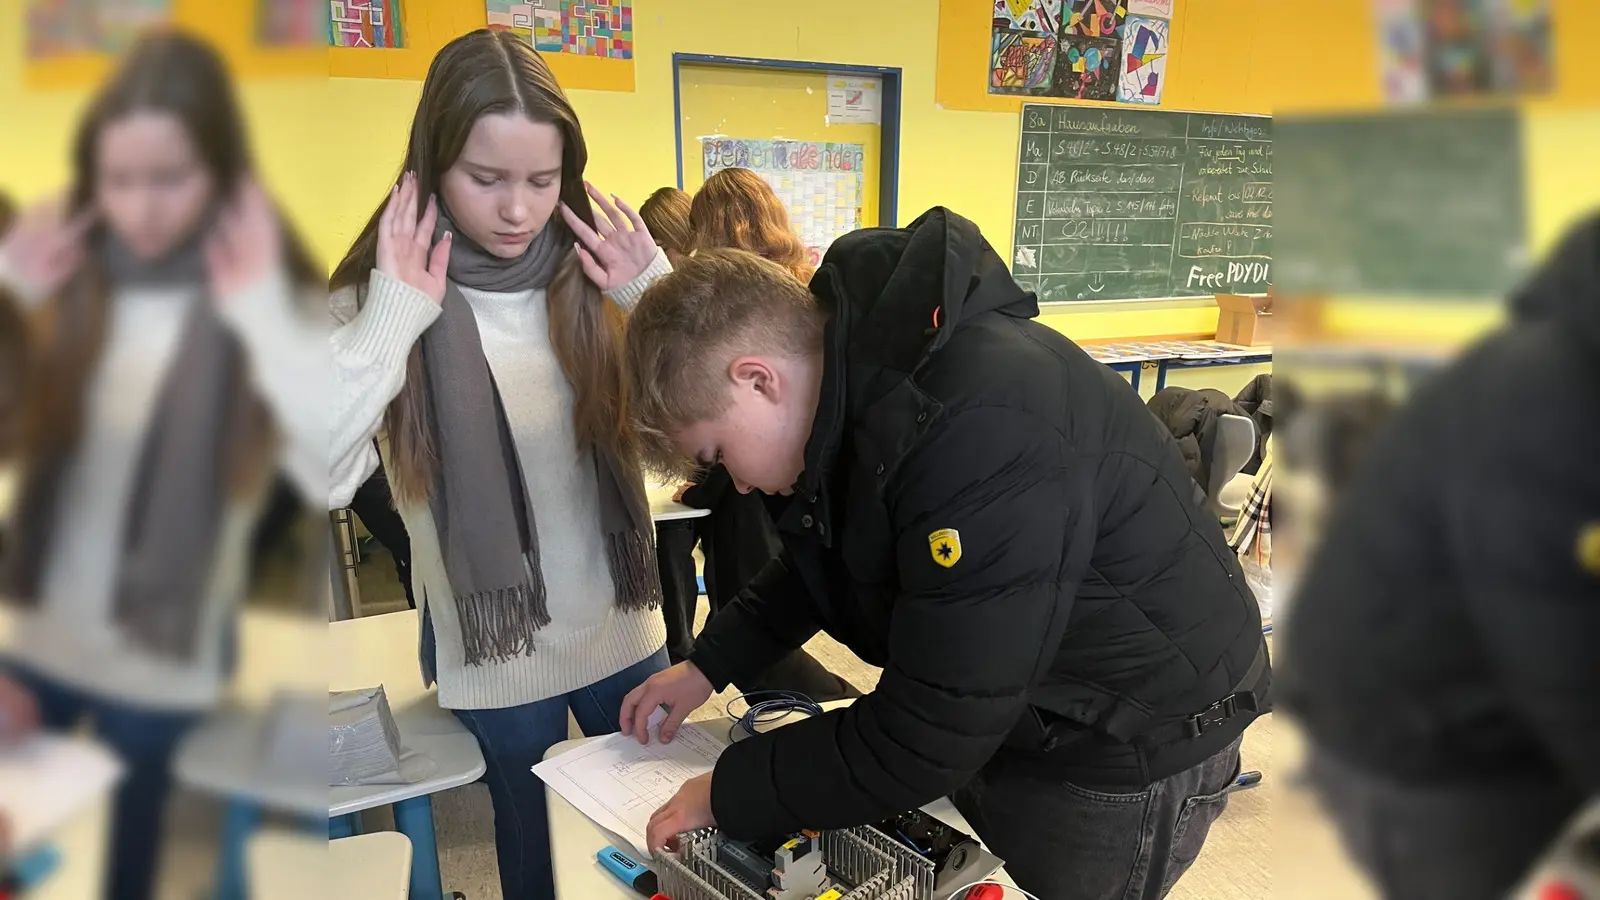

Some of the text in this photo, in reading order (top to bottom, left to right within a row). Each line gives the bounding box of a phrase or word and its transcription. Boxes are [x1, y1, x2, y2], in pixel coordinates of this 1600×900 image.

[1028, 111, 1046, 129] 8a
[1058, 110, 1141, 135] Hausaufgaben
[1025, 171, 1037, 184] D
[1026, 200, 1035, 214] E
[1022, 225, 1038, 239] NT
[1186, 264, 1225, 288] Free
